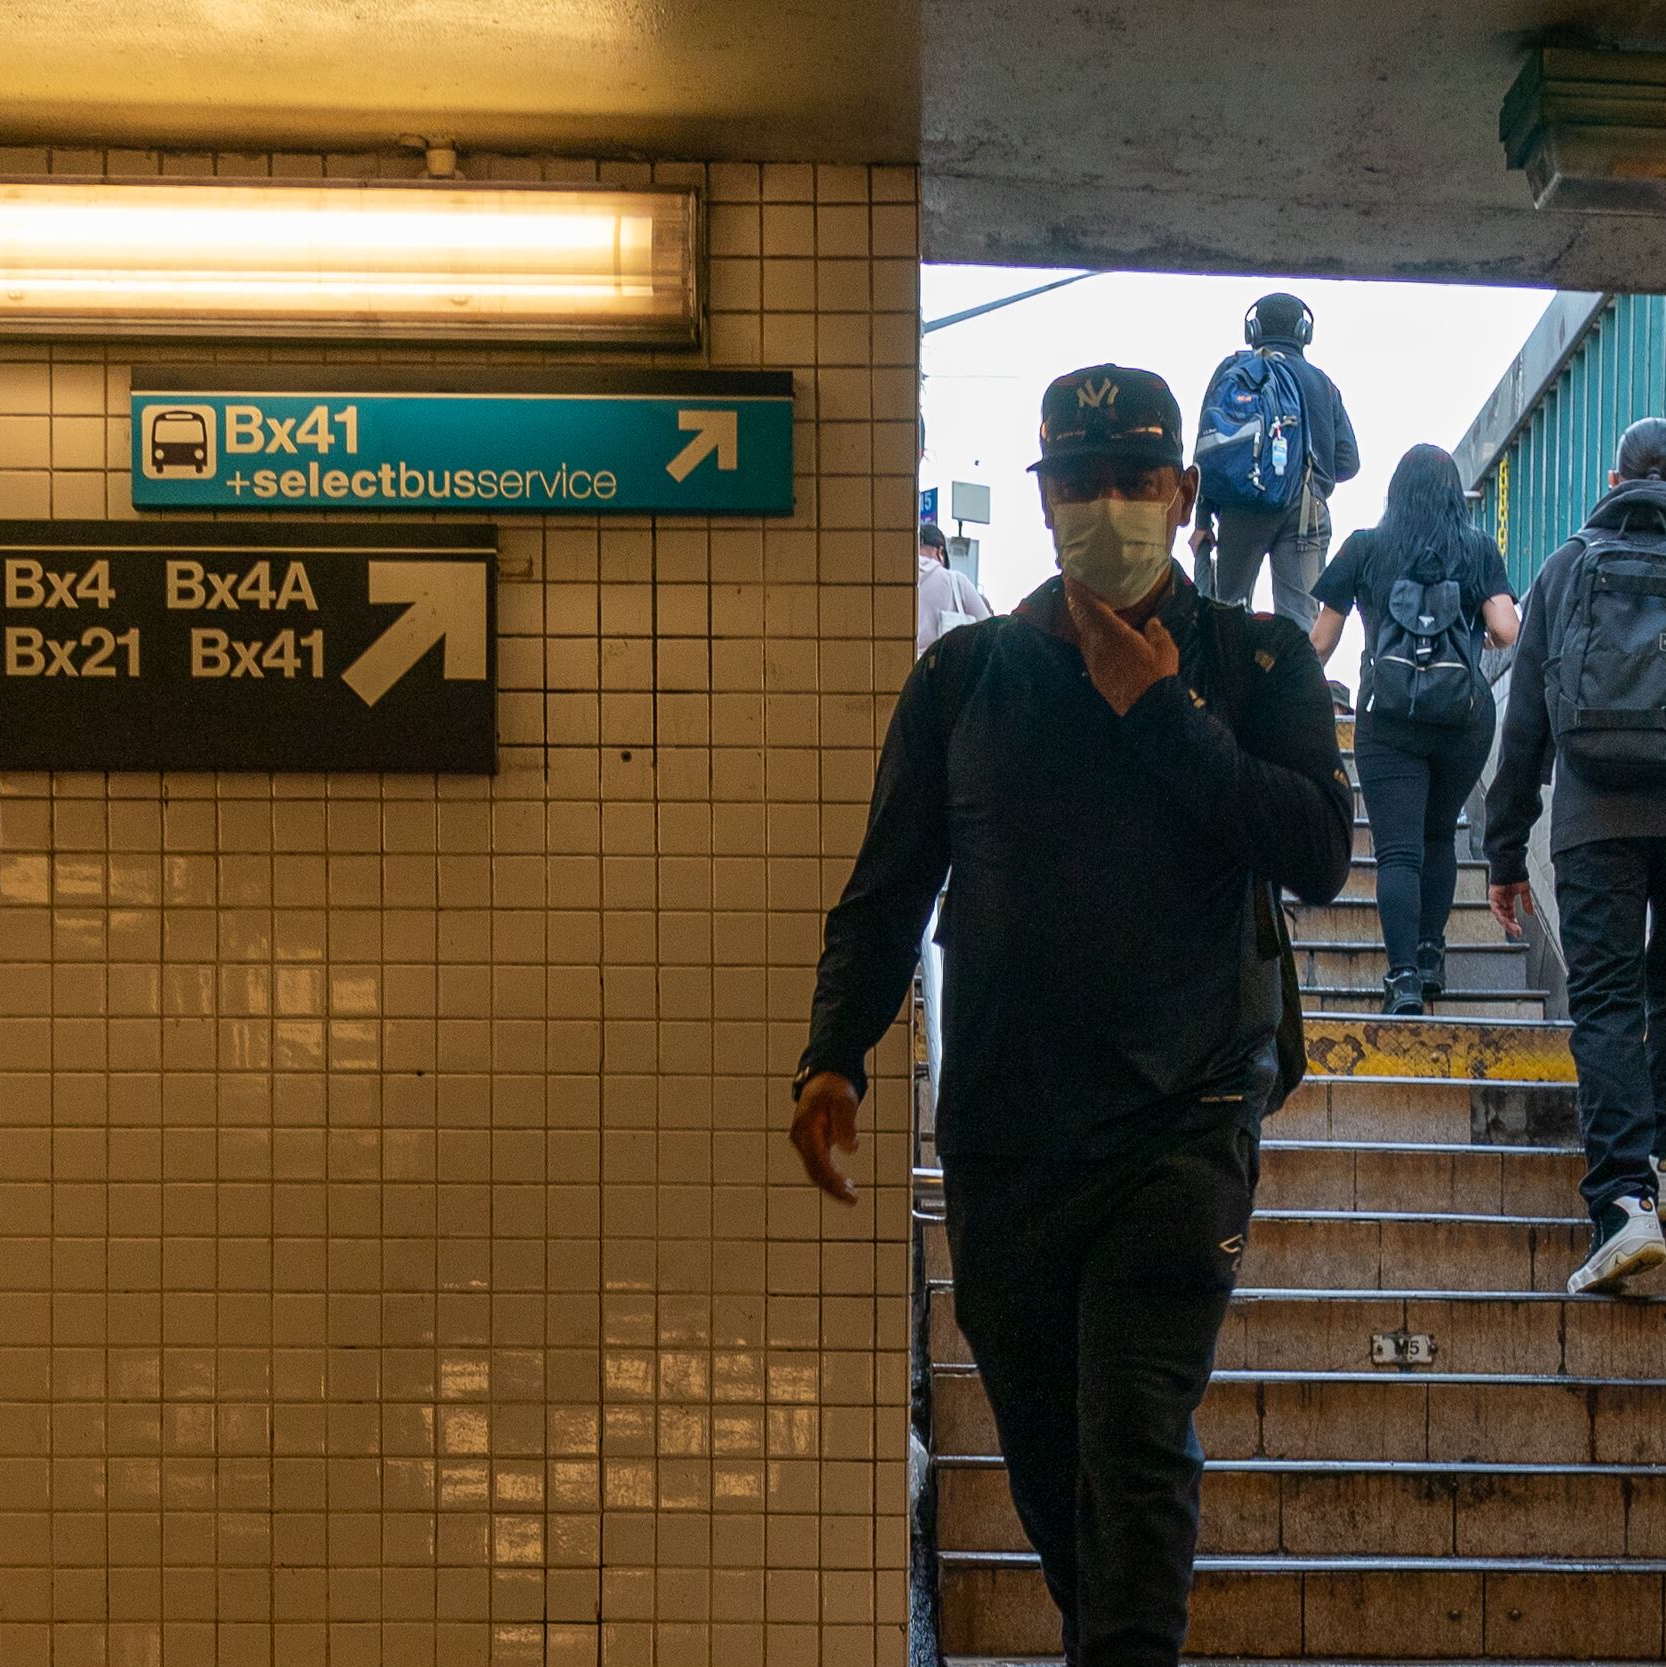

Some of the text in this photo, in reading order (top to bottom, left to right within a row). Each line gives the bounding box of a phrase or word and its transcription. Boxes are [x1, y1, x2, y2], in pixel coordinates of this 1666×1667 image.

[224, 404, 358, 454] Bx41
[226, 460, 618, 499] +selectbusservice
[5, 558, 318, 611] Bx4 Bx4A
[5, 629, 324, 678] Bx21 Bx41
